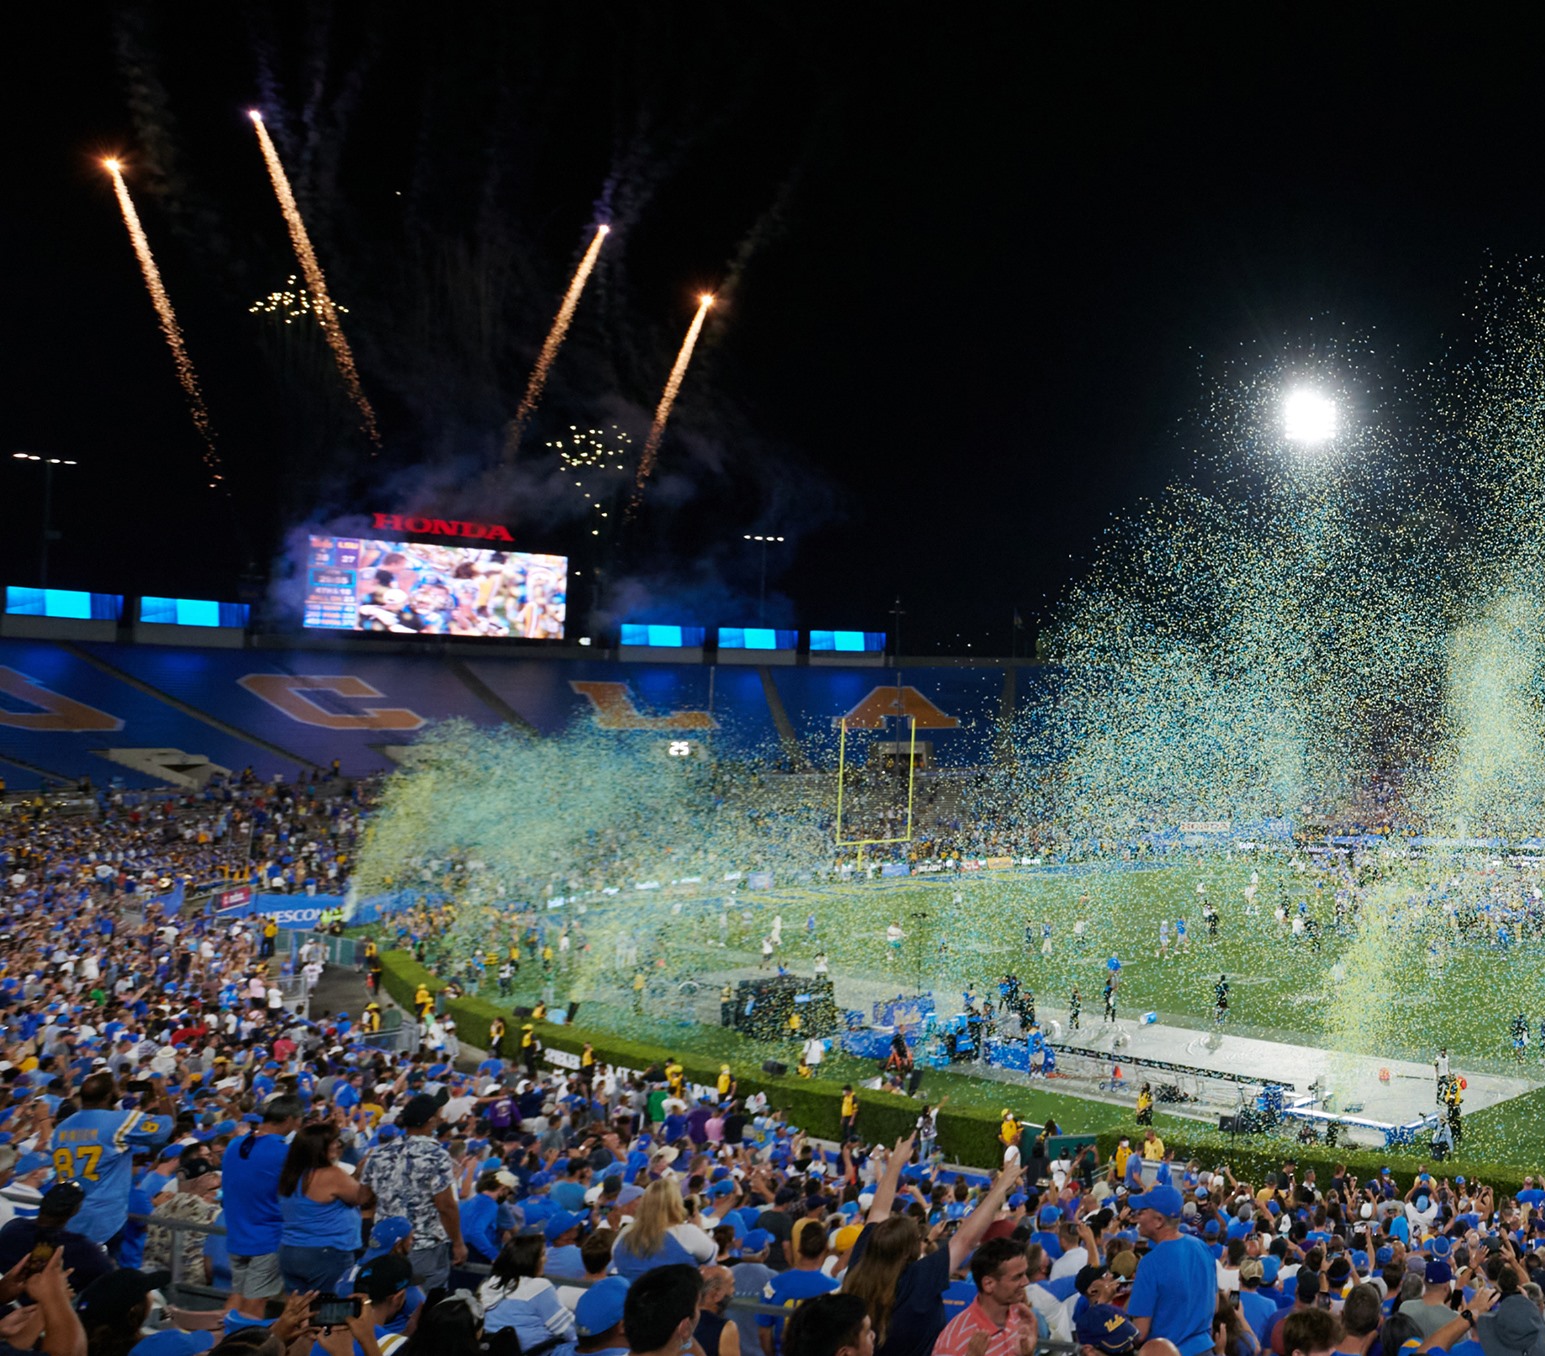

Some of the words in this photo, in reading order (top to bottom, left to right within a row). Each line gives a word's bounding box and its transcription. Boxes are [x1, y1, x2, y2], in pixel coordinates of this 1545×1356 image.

[372, 512, 515, 541] HONDA
[669, 741, 690, 756] 25
[53, 1144, 103, 1184] 87
